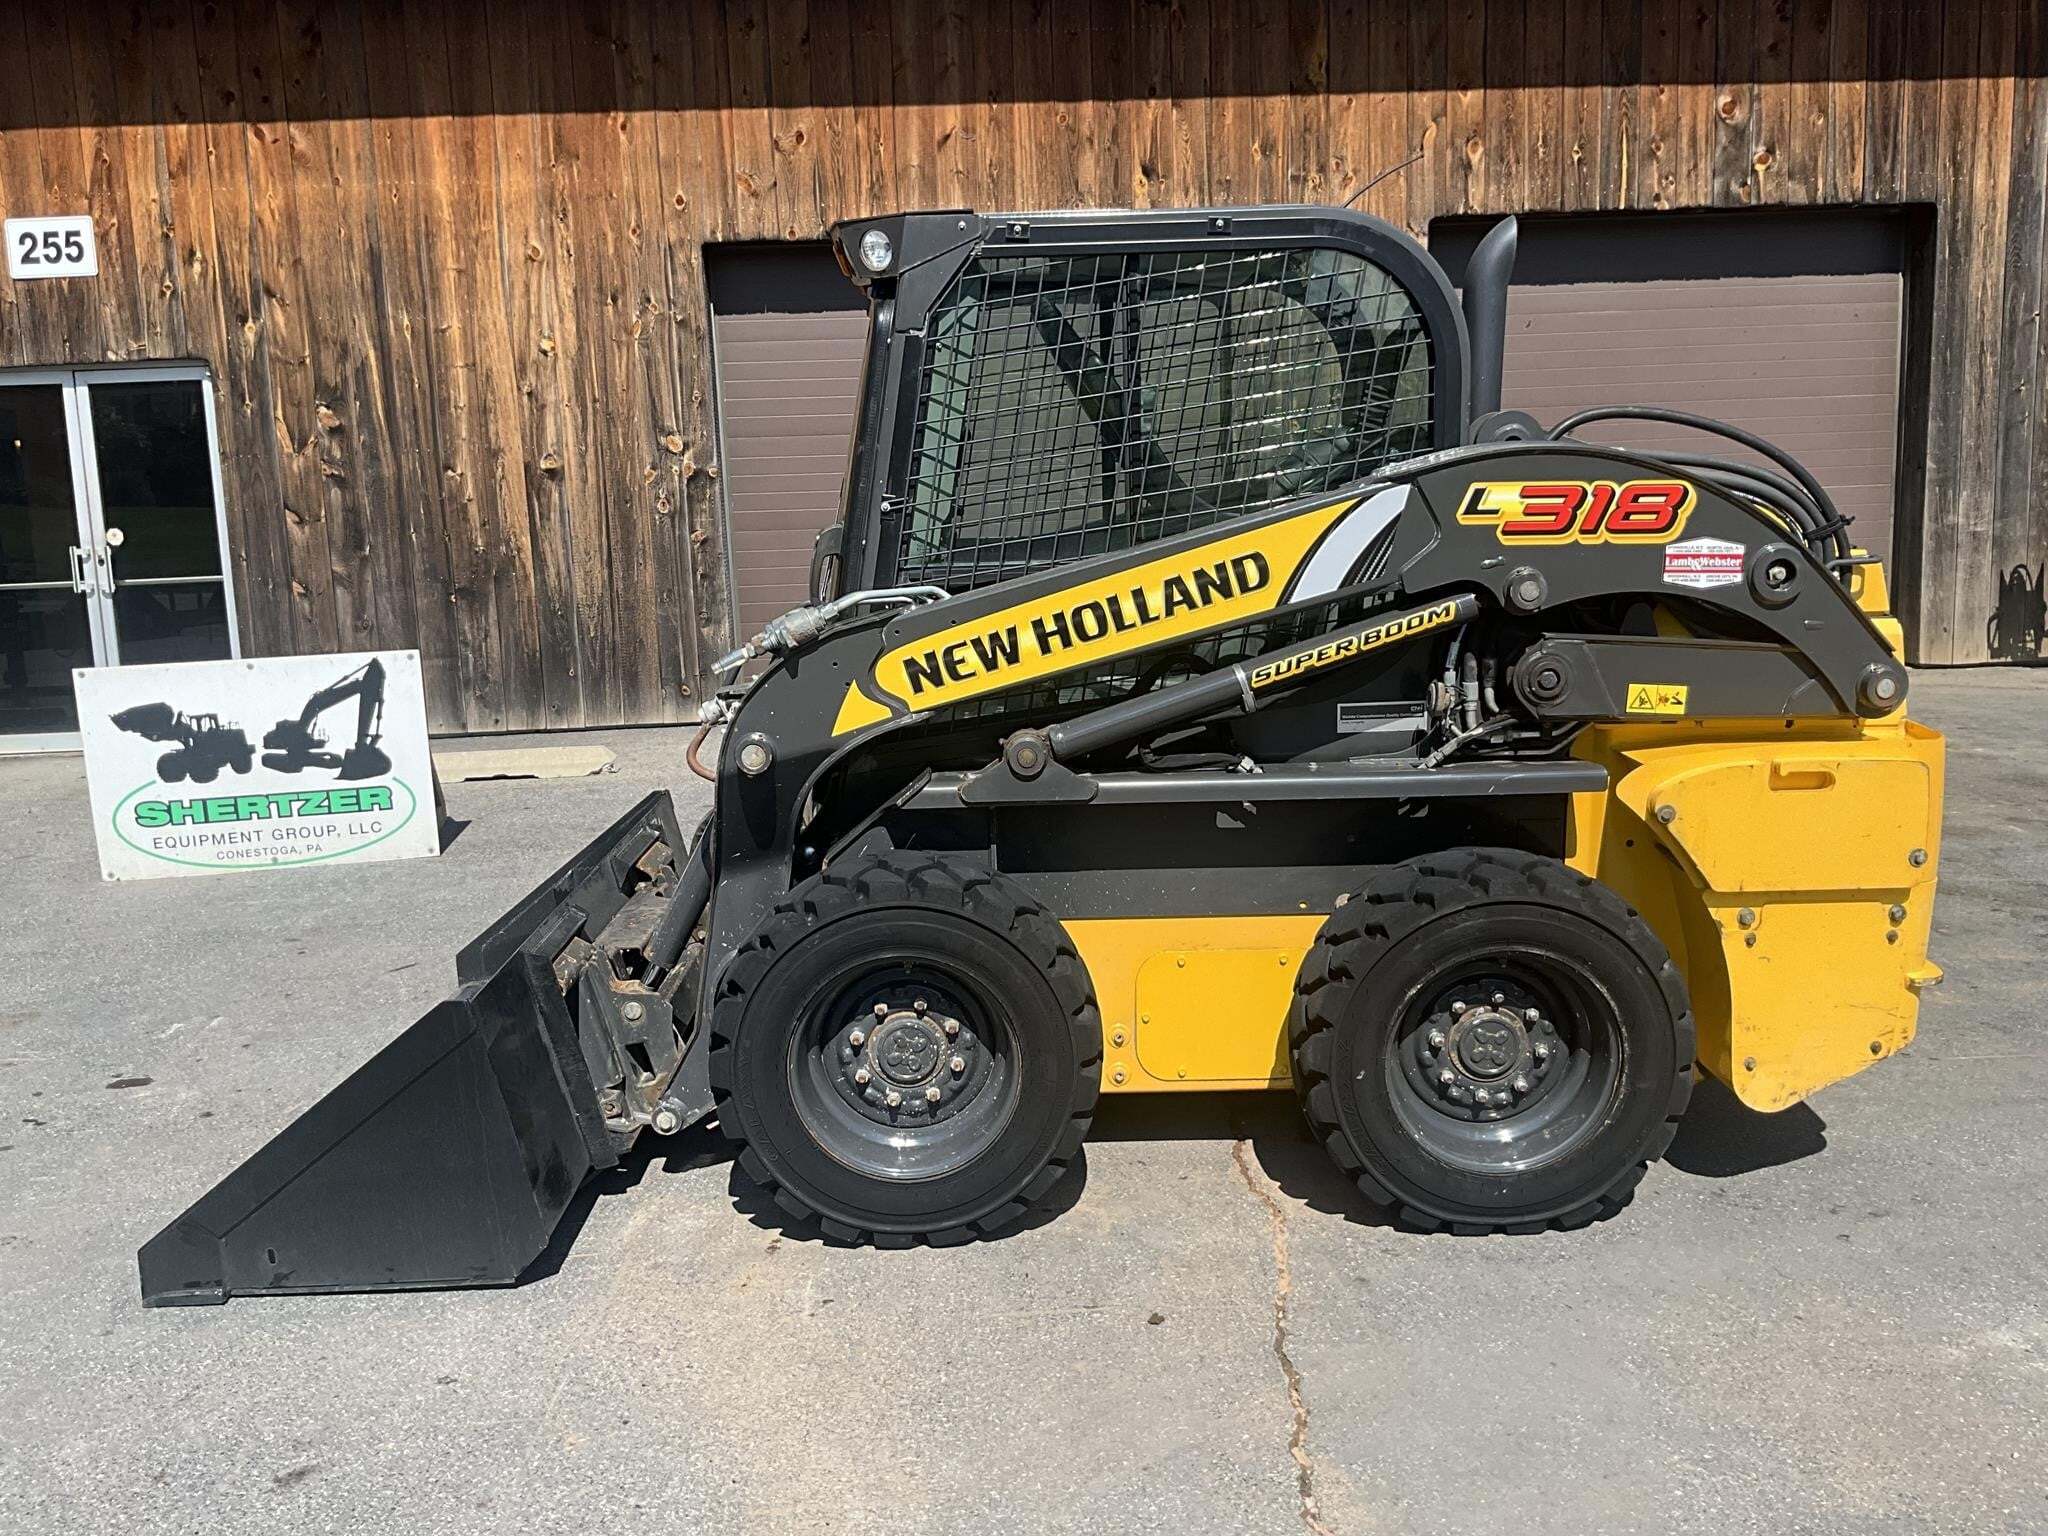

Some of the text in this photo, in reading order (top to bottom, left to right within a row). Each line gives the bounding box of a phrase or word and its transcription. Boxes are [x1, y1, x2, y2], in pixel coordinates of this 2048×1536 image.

[18, 230, 84, 265] 255
[1460, 483, 1692, 538] L318
[903, 551, 1271, 696] NEW HOLLAND
[1252, 601, 1457, 688] SUPER BOOM
[134, 785, 394, 828] SHERTZER
[153, 821, 383, 850] EQUIPMENT GROUP, LLC
[216, 844, 324, 860] CONESTOGA, PA
